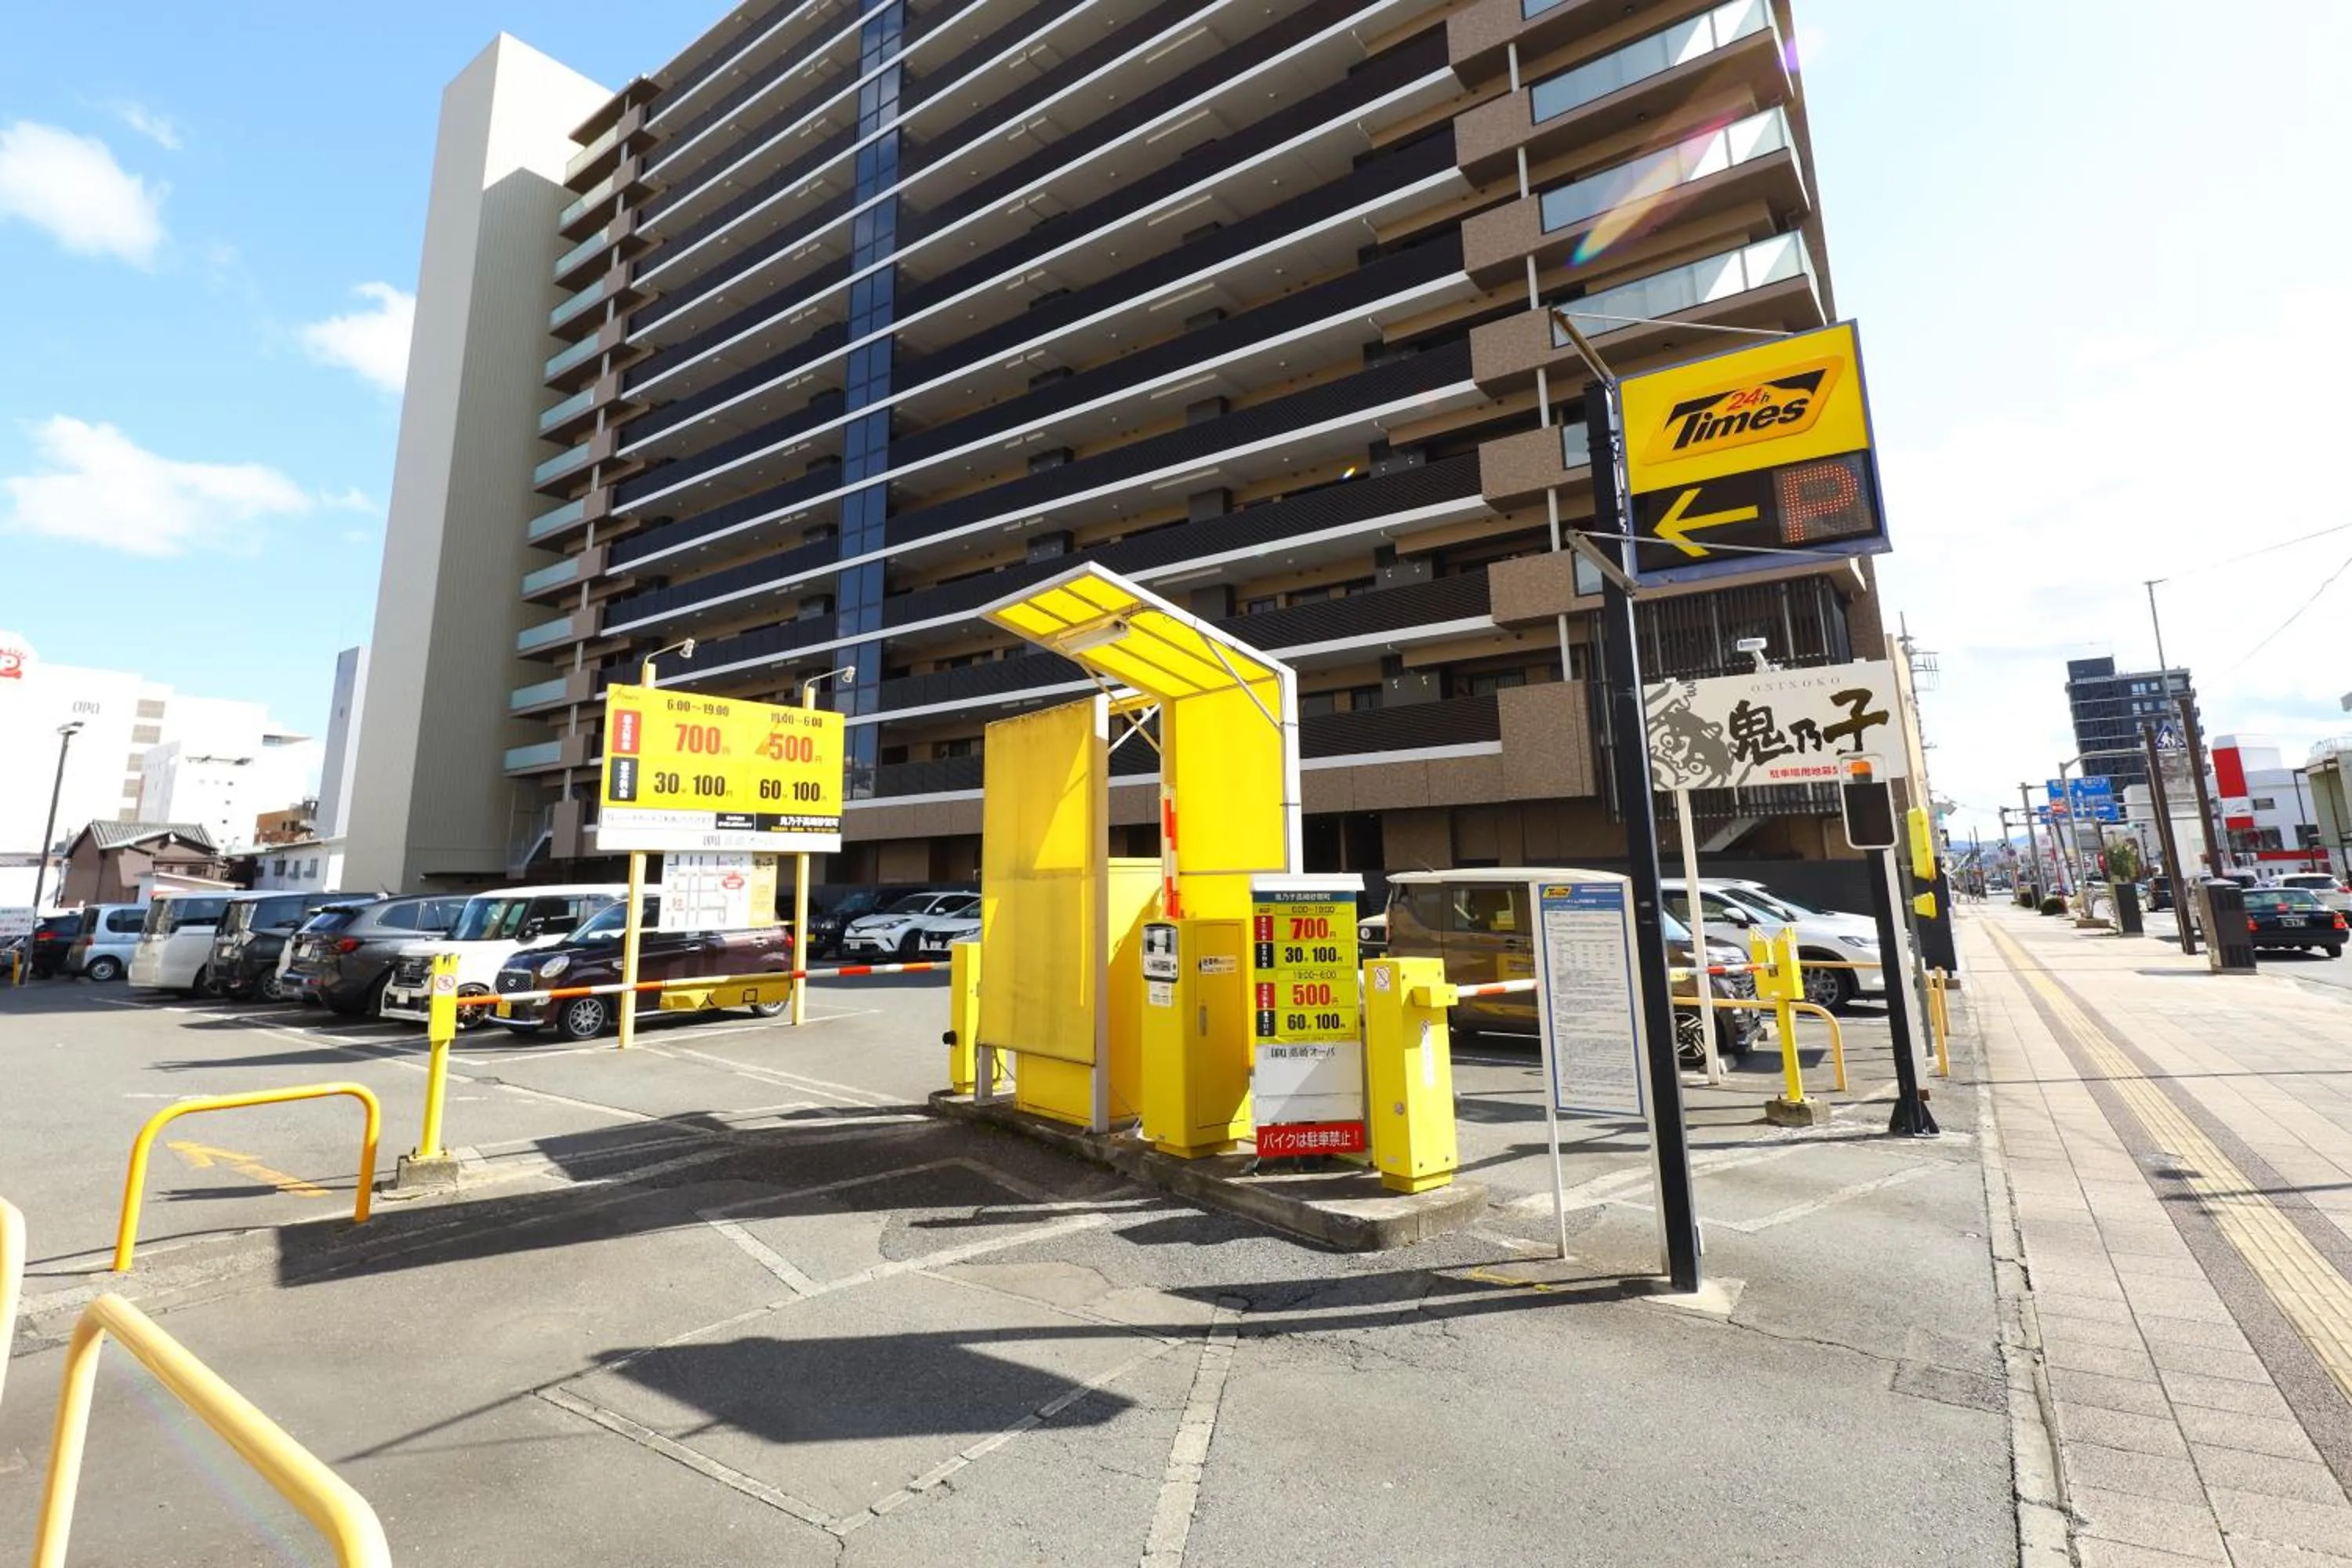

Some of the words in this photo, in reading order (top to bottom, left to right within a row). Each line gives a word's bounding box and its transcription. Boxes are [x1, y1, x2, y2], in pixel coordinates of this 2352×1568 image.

[1671, 397, 1809, 452] Times
[1782, 463, 1858, 543] P
[1729, 688, 1890, 765] 鬼乃子
